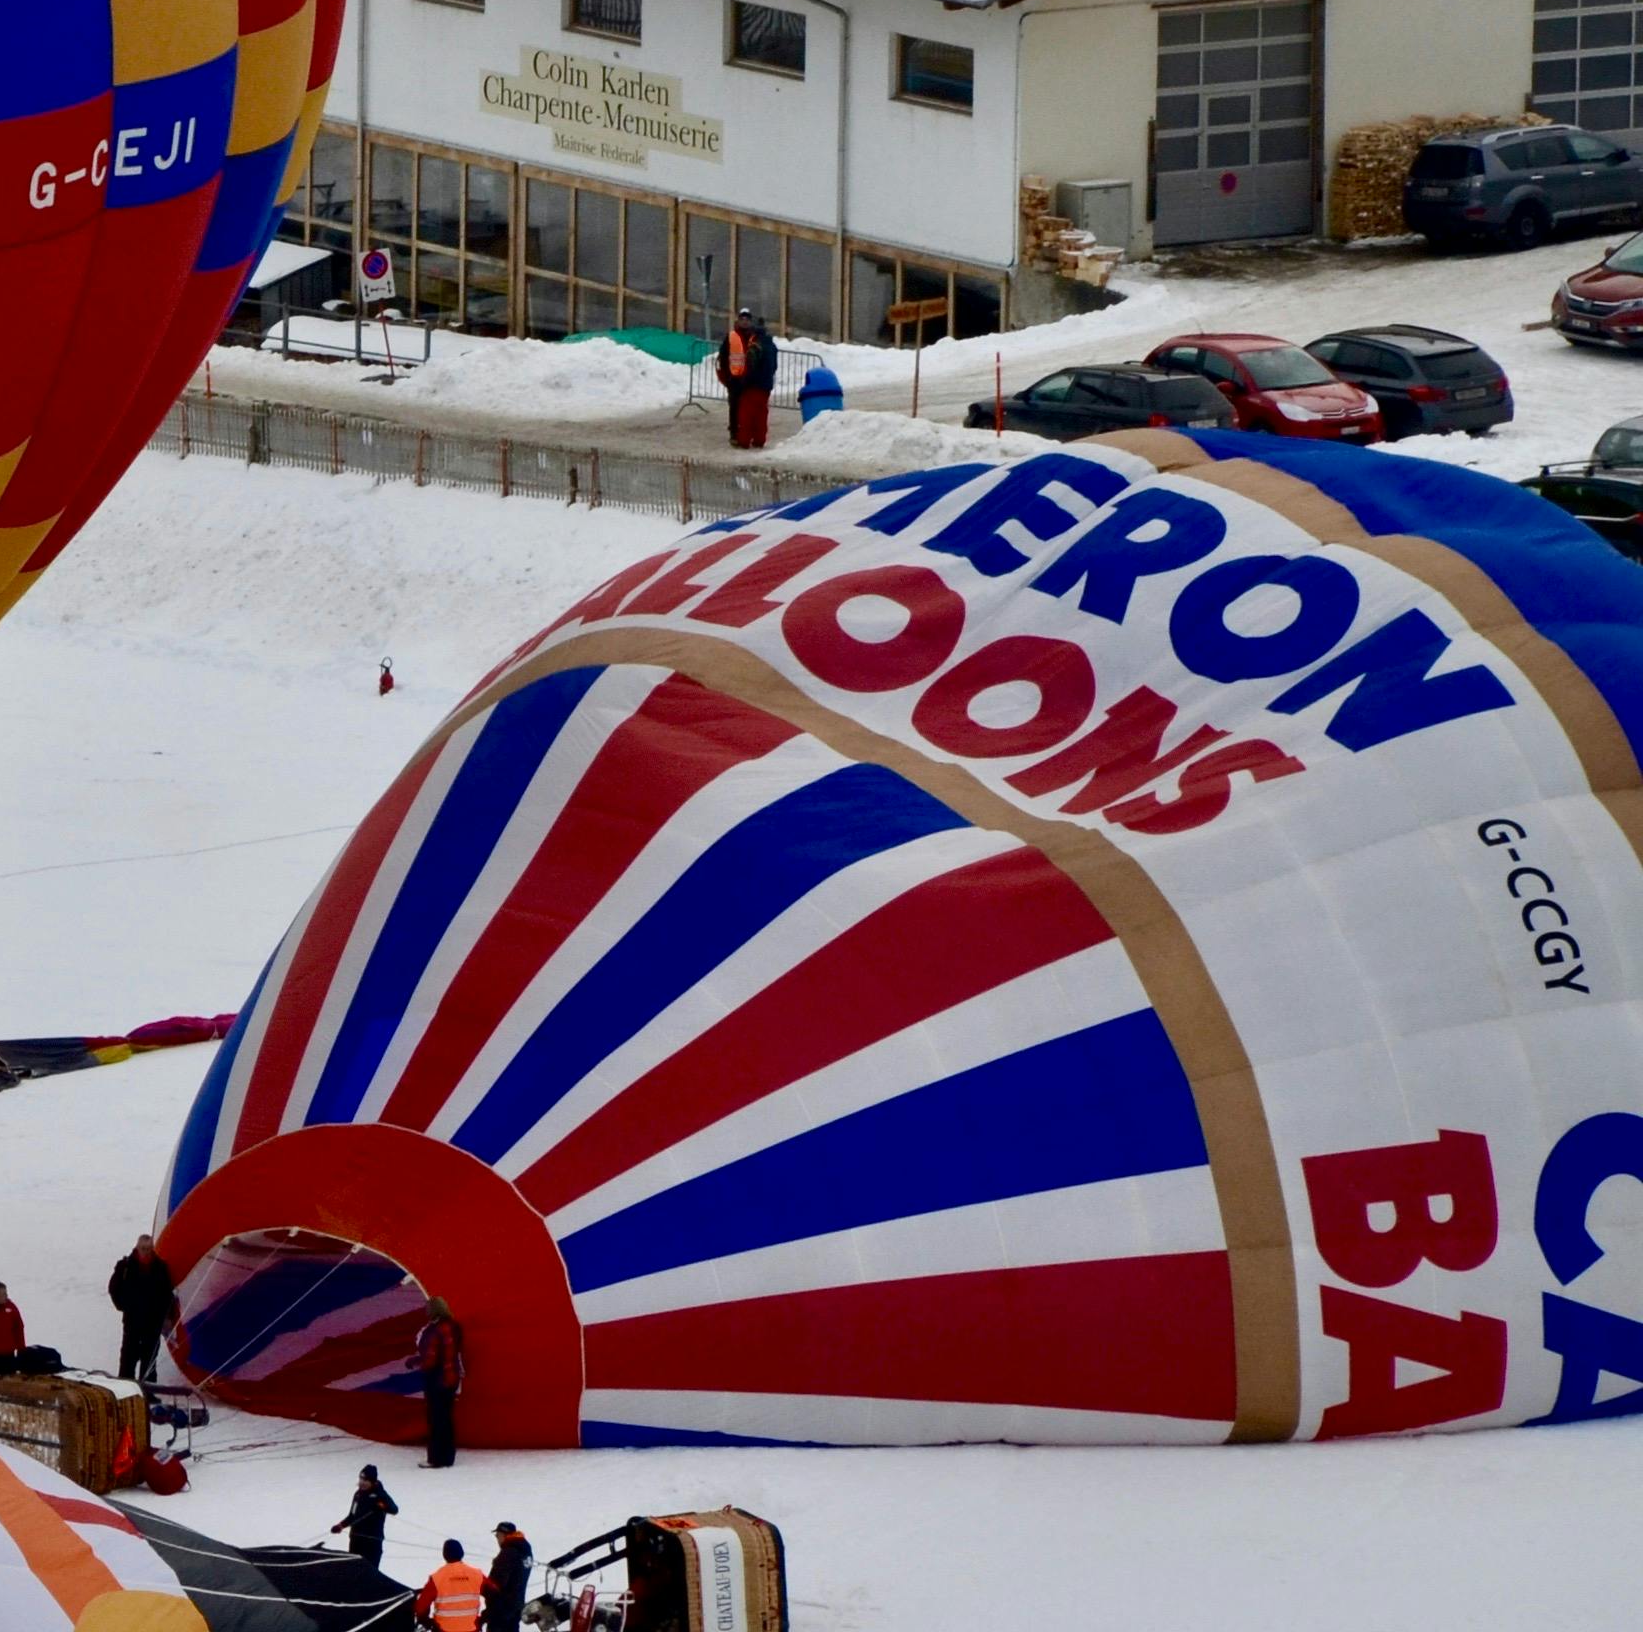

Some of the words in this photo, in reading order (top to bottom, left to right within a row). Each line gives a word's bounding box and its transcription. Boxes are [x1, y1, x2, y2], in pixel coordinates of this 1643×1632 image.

[533, 50, 588, 90] Colin
[601, 66, 670, 107] Karlen
[29, 117, 196, 209] G-CEJI
[1478, 818, 1591, 995] G-CCGY
